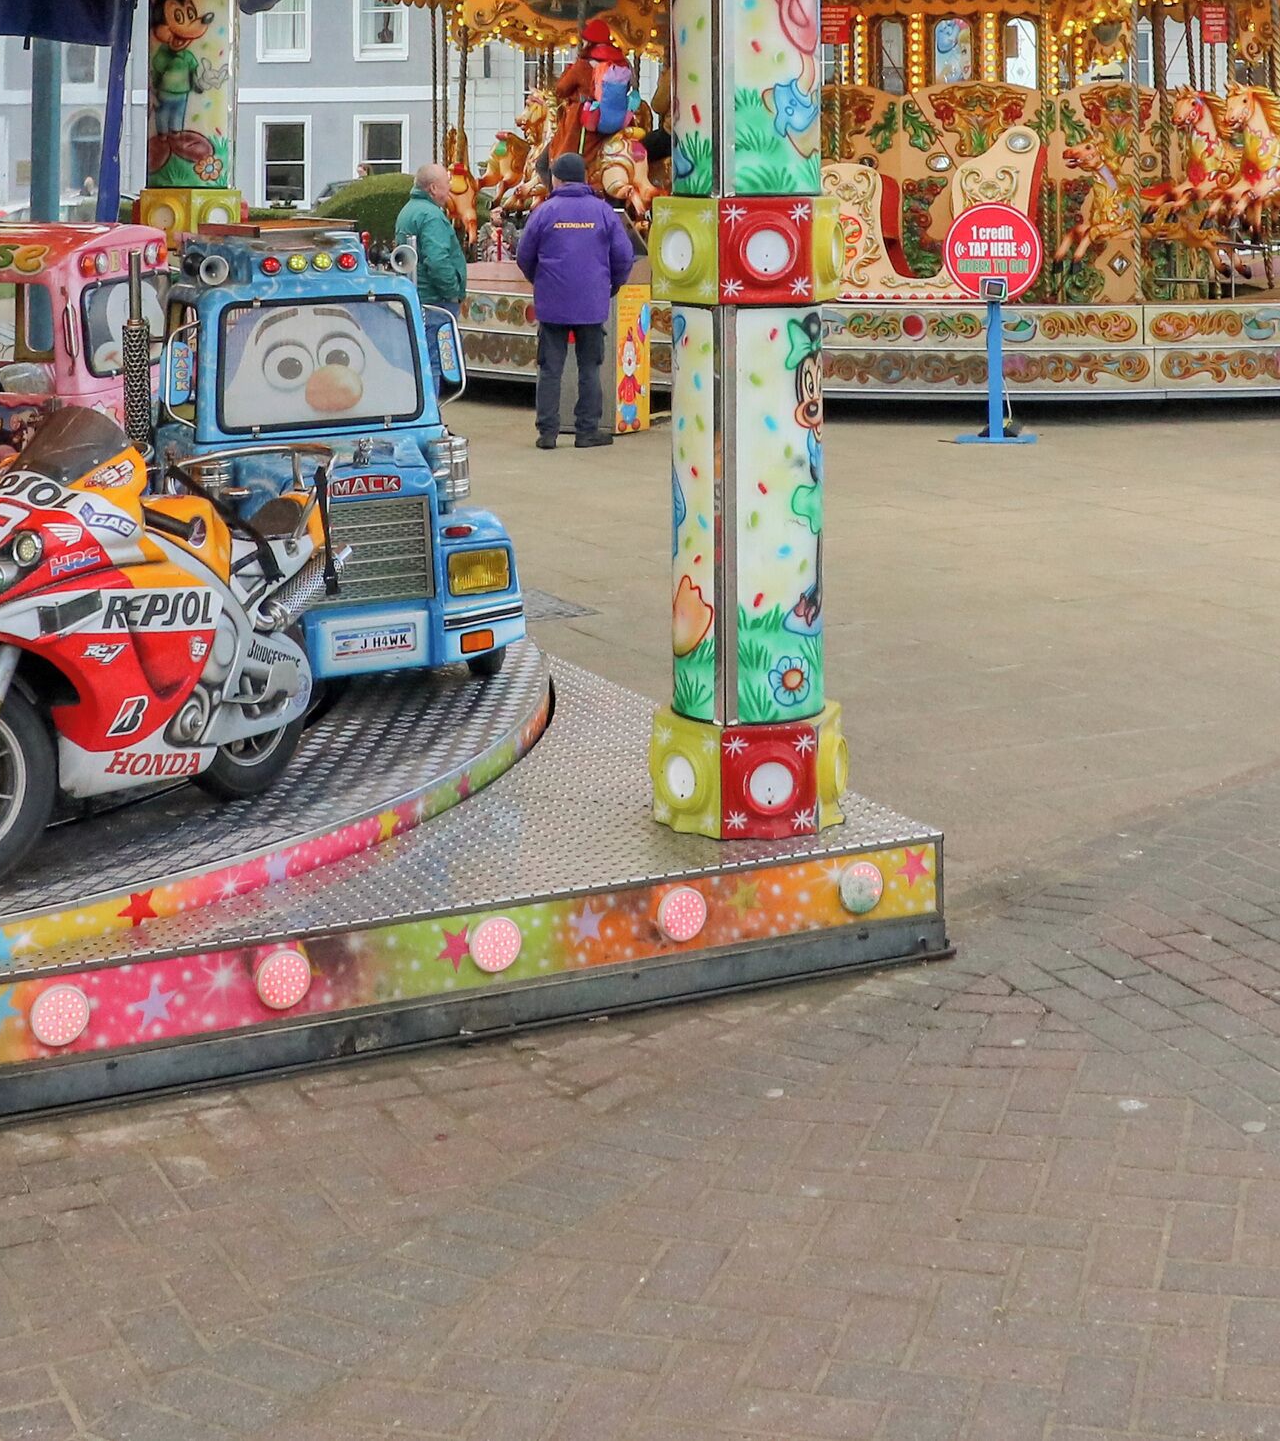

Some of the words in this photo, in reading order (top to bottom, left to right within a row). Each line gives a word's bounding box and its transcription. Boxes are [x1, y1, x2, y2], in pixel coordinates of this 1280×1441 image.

[971, 224, 978, 240] 1
[979, 224, 1014, 240] credit
[968, 241, 989, 257] TAP
[990, 241, 1018, 257] HERE
[957, 258, 991, 274] GREEN
[993, 258, 1007, 274] TO
[1009, 258, 1029, 274] GO!
[438, 330, 455, 371] MACK
[173, 347, 190, 392] MACK
[333, 476, 400, 495] MACK
[87, 514, 136, 536] GAS
[102, 591, 214, 630] REPSOL
[190, 642, 208, 657] 93
[372, 634, 408, 648] H4WK
[104, 750, 201, 776] HONDA
